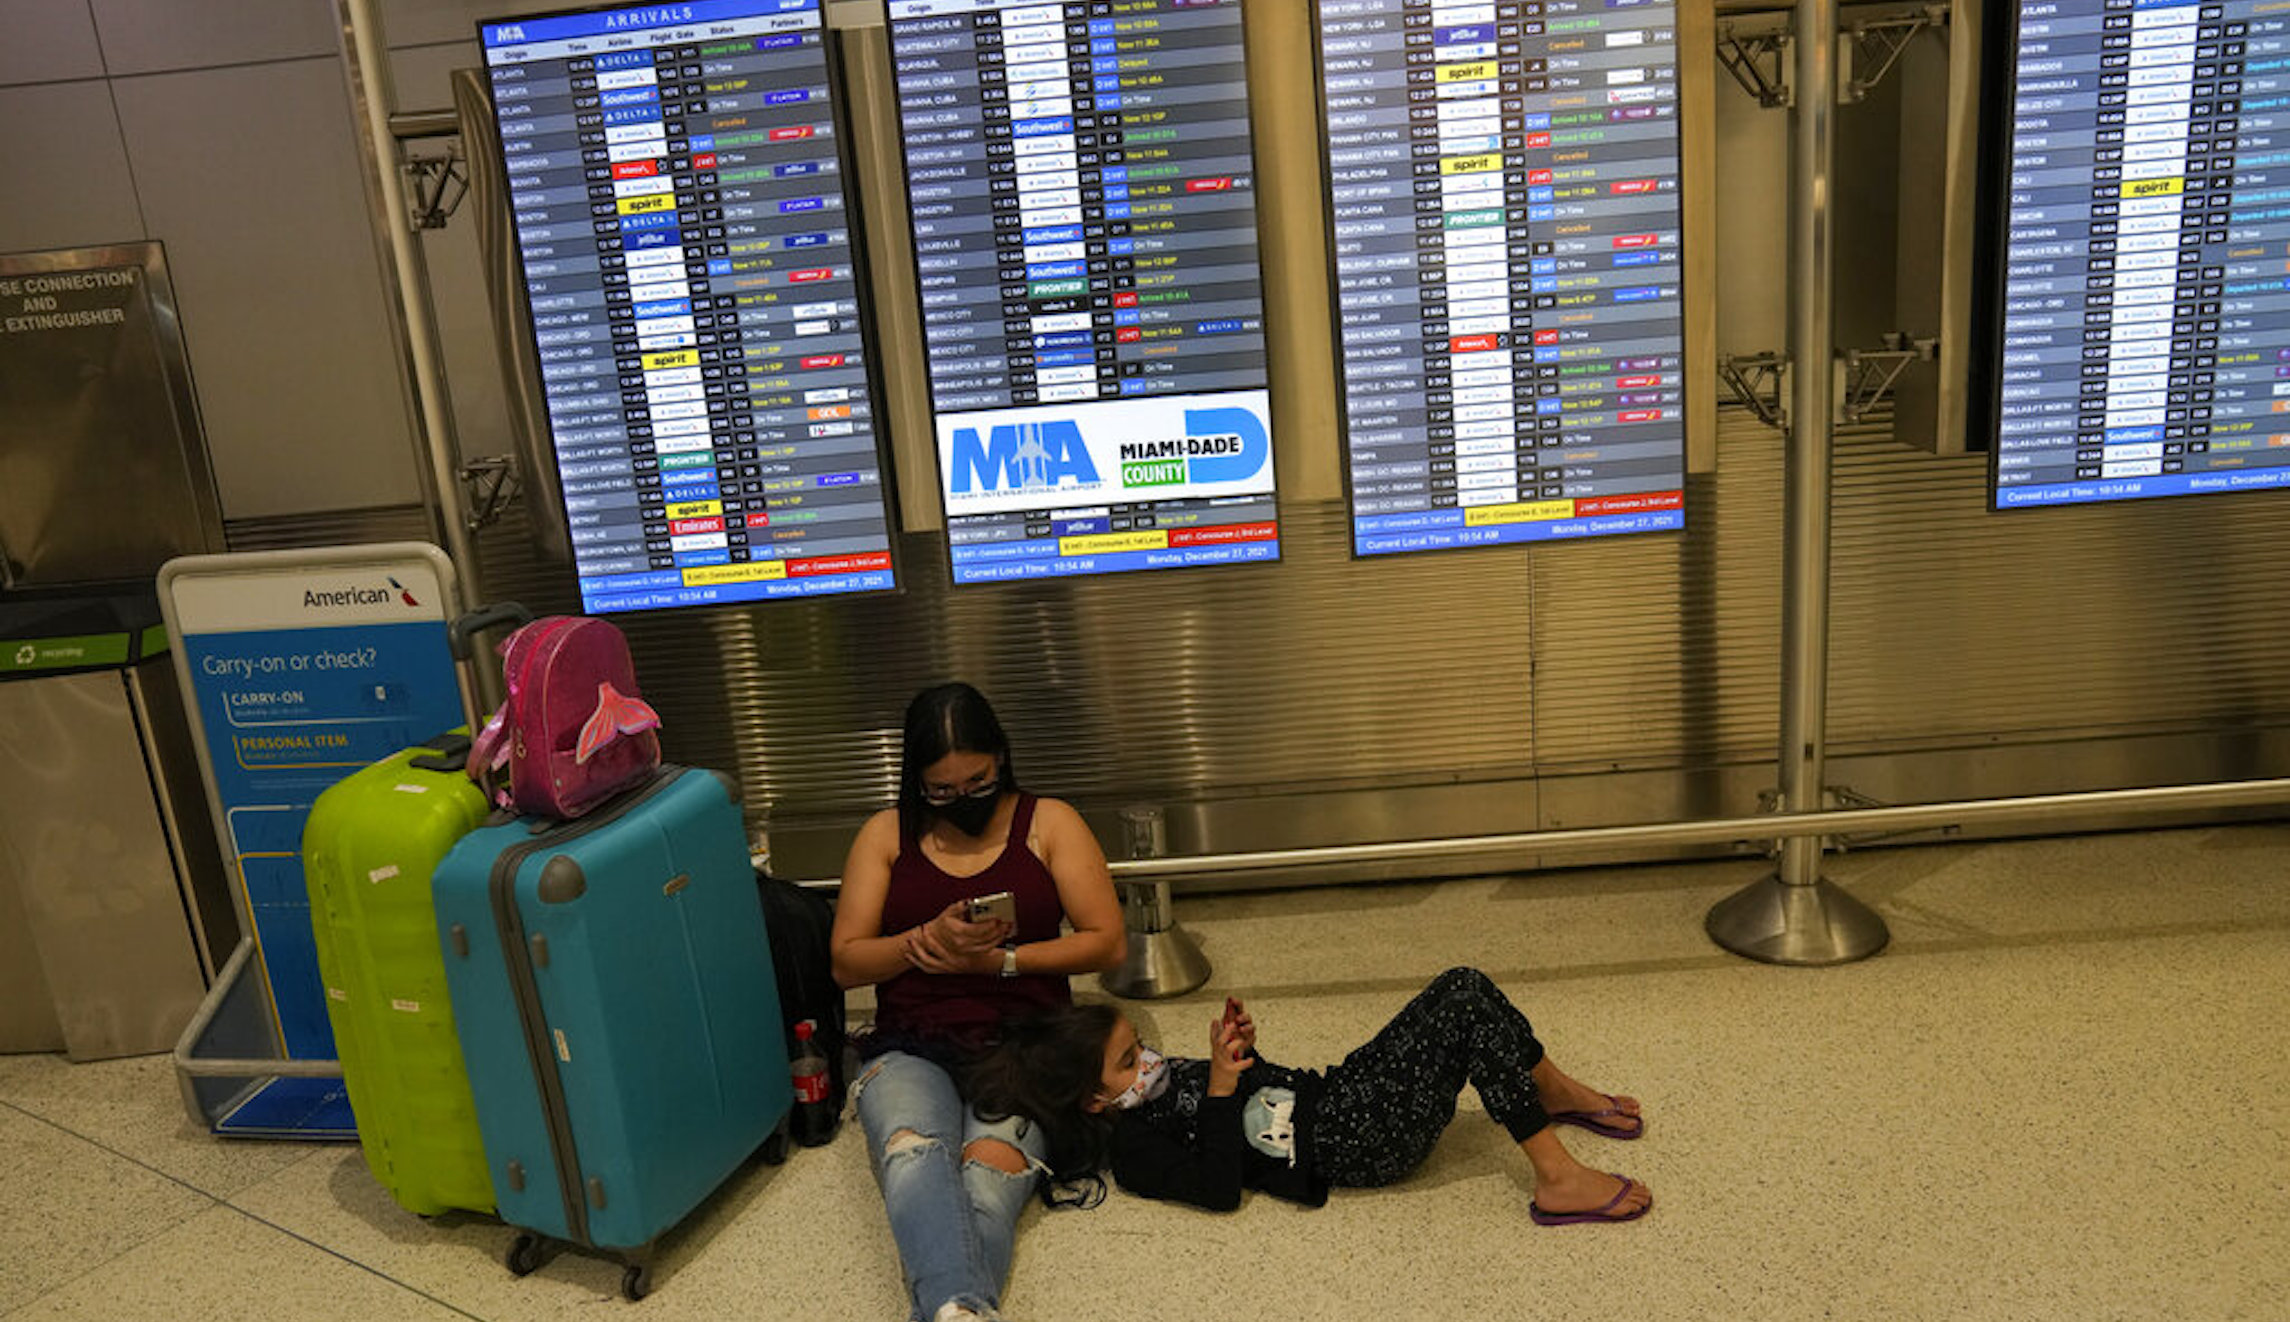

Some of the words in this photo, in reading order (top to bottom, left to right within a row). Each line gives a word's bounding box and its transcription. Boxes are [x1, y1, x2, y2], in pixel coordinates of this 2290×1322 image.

[605, 6, 692, 27] ARRIVALS
[567, 41, 588, 51] Time
[607, 36, 632, 47] Airline
[649, 31, 672, 43] Flight
[674, 29, 694, 39] Gate
[710, 24, 734, 34] Status
[770, 15, 803, 28] Partners
[1449, 28, 1479, 40] jetBlue
[1448, 65, 1484, 80] spirit
[602, 88, 650, 104] Southwest
[615, 109, 648, 120] DELTA
[1014, 119, 1064, 135] Southwest
[1453, 157, 1488, 171] spirit
[2133, 181, 2170, 195] spirit
[629, 198, 663, 211] spirit
[631, 215, 664, 226] DELTA
[1449, 211, 1500, 225] FRONTIER
[1025, 229, 1074, 243] Southwest
[1029, 264, 1077, 279] Southwest
[25, 272, 134, 293] CONNECTION
[1033, 281, 1083, 294] FRONTIER
[24, 296, 57, 312] AND
[636, 301, 682, 315] Southwest
[6, 308, 125, 333] EXTINGUISHER
[653, 354, 687, 366] spirit
[2107, 430, 2154, 442] Southwest
[1119, 434, 1239, 461] MIAMI-DADE
[662, 453, 709, 466] FRONTIER
[662, 470, 707, 483] Southwest
[1123, 461, 1184, 484] COUNTY
[2191, 478, 2228, 489] Monday,
[2231, 474, 2278, 486] December
[675, 488, 706, 498] DELTA
[2008, 491, 2042, 503] Current
[2044, 489, 2069, 500] Local
[2073, 487, 2094, 498] Time:
[2099, 486, 2124, 496] 10:54
[2126, 483, 2141, 494] AM
[677, 504, 710, 516] spirit
[674, 518, 720, 533] Emirates
[1551, 522, 1586, 534] Monday,
[1589, 518, 1634, 531] December
[1366, 538, 1400, 550] Current
[1402, 536, 1426, 547] Local
[1429, 534, 1452, 545] Time:
[1484, 530, 1499, 540] AM
[1146, 551, 1182, 564] Monday,
[1184, 548, 1229, 561] December
[1247, 545, 1268, 557] 2021
[963, 567, 997, 578] Current
[998, 565, 1022, 576] Local
[1025, 563, 1048, 574] Time:
[1054, 561, 1078, 572] 10:54
[1079, 559, 1095, 570] AM
[766, 582, 801, 594] Monday,
[802, 578, 846, 591] December
[847, 577, 861, 587] 27,
[862, 575, 882, 586] 2021
[302, 586, 390, 608] American
[593, 598, 624, 609] Current
[626, 596, 649, 606] Local
[651, 594, 673, 604] Time:
[678, 591, 702, 602] 10:54
[702, 590, 717, 600] AM
[202, 654, 286, 679] Carry-on
[290, 656, 310, 671] or
[314, 647, 377, 670] check?
[231, 690, 305, 707] CARRY-ON
[242, 735, 311, 750] PERSONAL
[314, 734, 349, 748] ITEM
